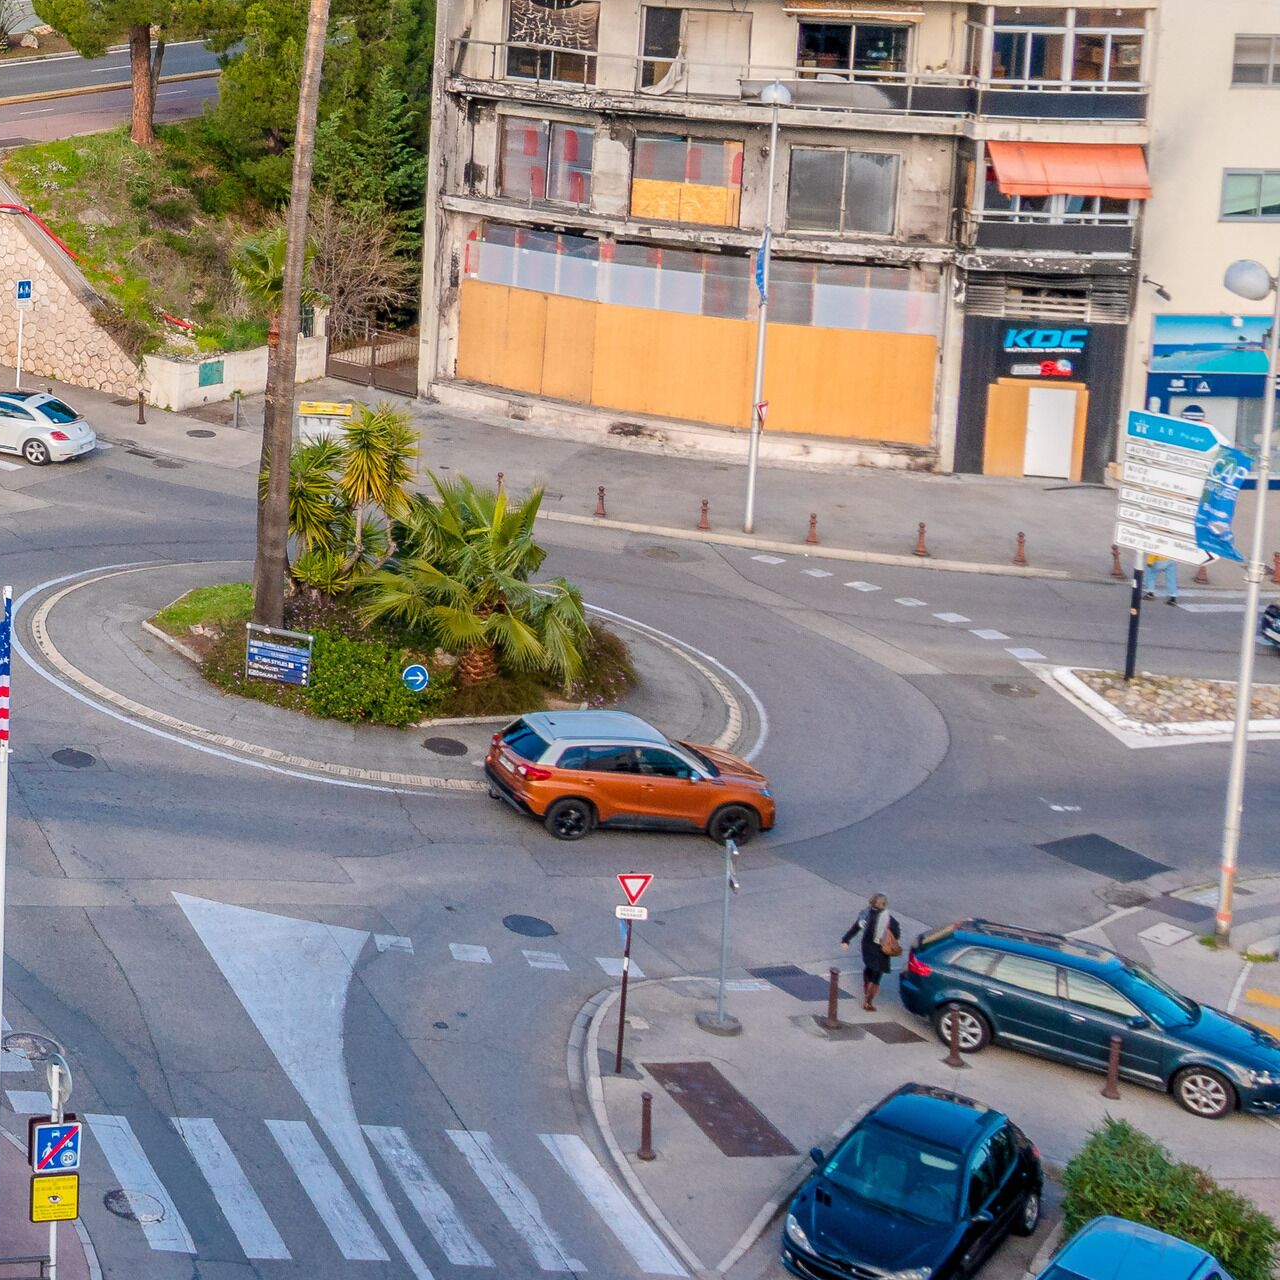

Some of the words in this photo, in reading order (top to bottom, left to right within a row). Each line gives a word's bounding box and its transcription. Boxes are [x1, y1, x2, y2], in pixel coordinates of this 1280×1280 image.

[1004, 328, 1088, 348] KDC
[1165, 453, 1209, 471] DIRECTION
[63, 1153, 74, 1162] 20
